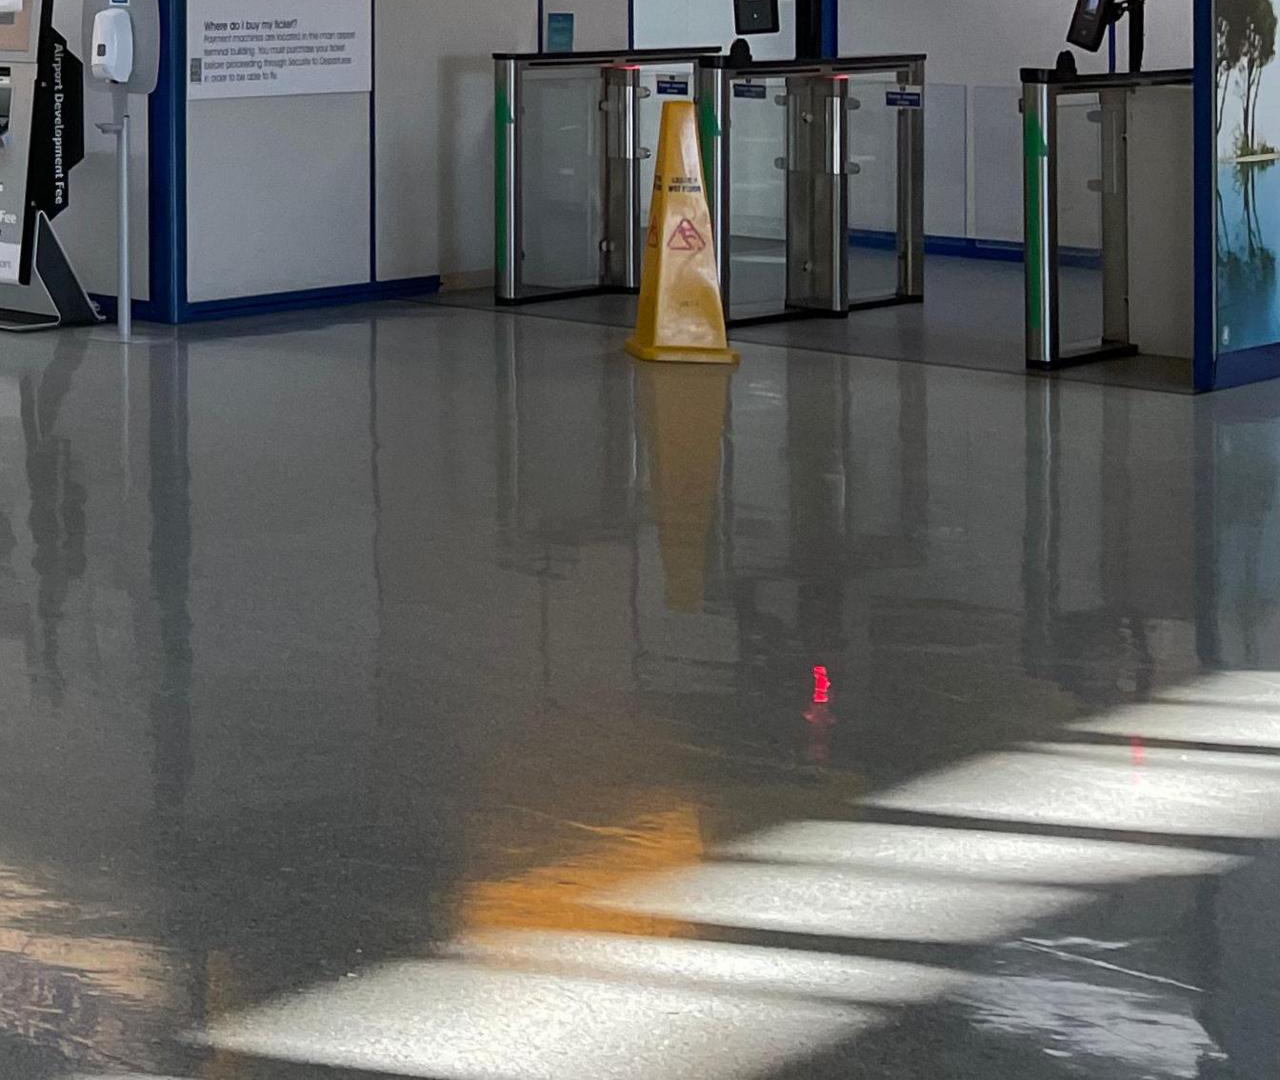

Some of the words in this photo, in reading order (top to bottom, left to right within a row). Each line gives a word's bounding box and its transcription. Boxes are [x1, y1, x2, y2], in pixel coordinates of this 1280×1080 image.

[53, 43, 64, 89] Airport
[53, 93, 65, 177] Development
[54, 180, 64, 205] Fee
[0, 210, 16, 224] Fee
